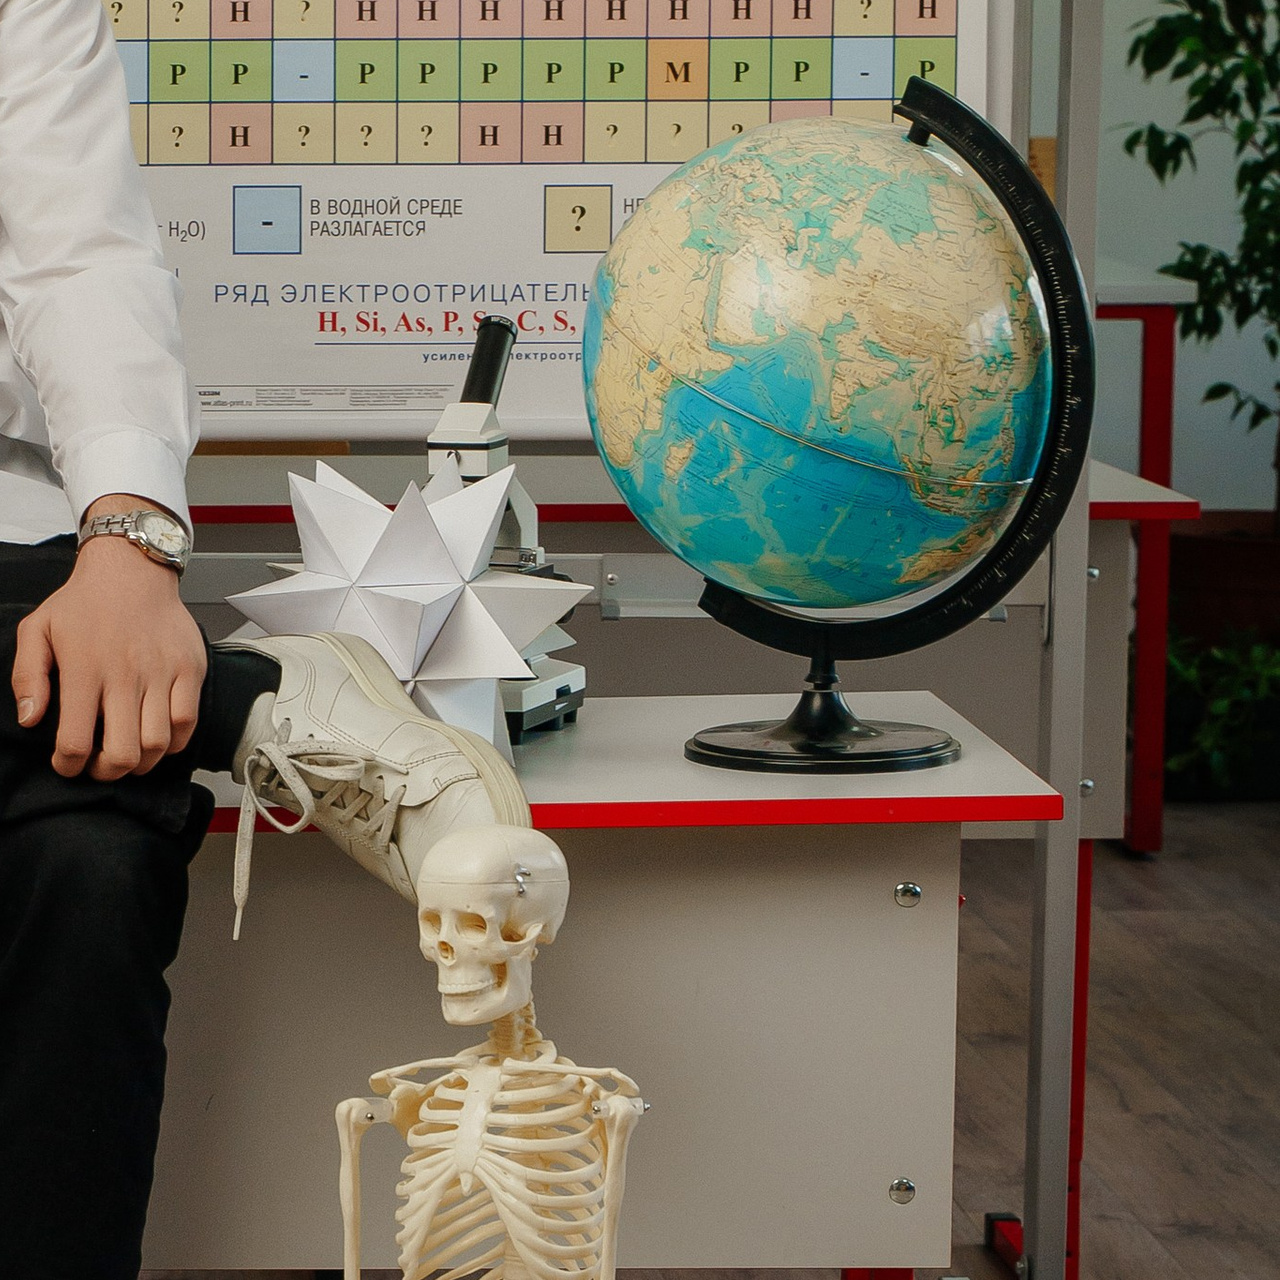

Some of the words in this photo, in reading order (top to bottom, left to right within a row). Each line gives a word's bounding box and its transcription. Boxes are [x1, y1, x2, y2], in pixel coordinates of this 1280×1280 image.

[230, 1, 250, 23] Н
[357, 0, 377, 22] Н
[170, 64, 187, 86] Р
[232, 63, 249, 85] Р
[666, 61, 690, 83] М
[794, 61, 810, 82] Р
[230, 125, 250, 147] Н
[479, 125, 499, 146] Н
[543, 125, 563, 146] Н
[310, 199, 321, 215] В
[327, 196, 400, 219] ВОДНОЙ
[407, 198, 463, 218] СРЕДЕ
[310, 220, 426, 237] РАЗЛАГАЕТСЯ
[214, 284, 270, 307] РЯД
[317, 310, 348, 335] H,
[355, 310, 388, 335] Si,
[394, 311, 434, 335] As,
[442, 311, 466, 335] P,
[552, 310, 578, 335] S,
